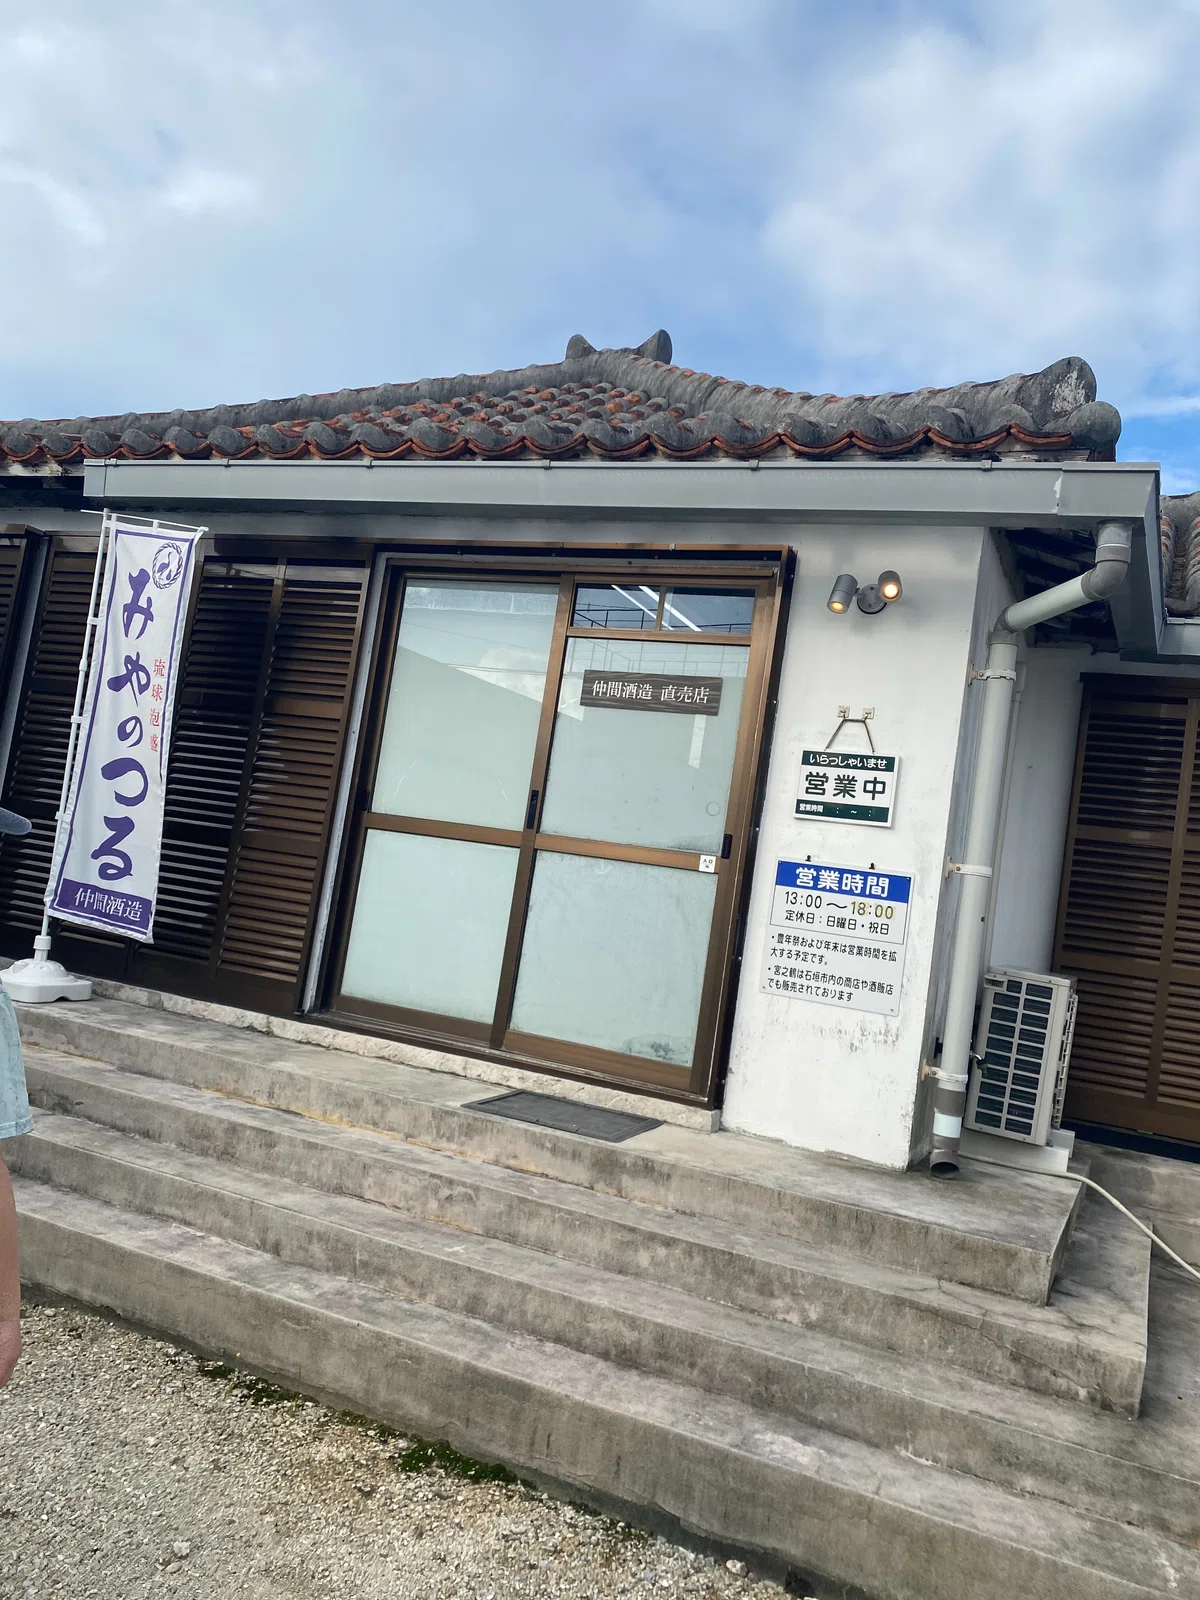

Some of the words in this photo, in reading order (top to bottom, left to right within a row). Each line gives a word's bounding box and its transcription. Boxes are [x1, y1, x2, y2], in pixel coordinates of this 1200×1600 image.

[592, 680, 653, 700] 仲間酒造
[660, 685, 709, 704] 直売店
[91, 568, 154, 881] みやのつる
[809, 753, 887, 769] いらっしゃいませ
[805, 771, 886, 800] 営業中
[799, 803, 824, 813] 営業時間
[796, 867, 890, 897] 営業時間
[74, 887, 143, 921] 仲間酒造
[770, 947, 828, 966] 大する予定です。
[768, 978, 853, 1002] でも販売されております
